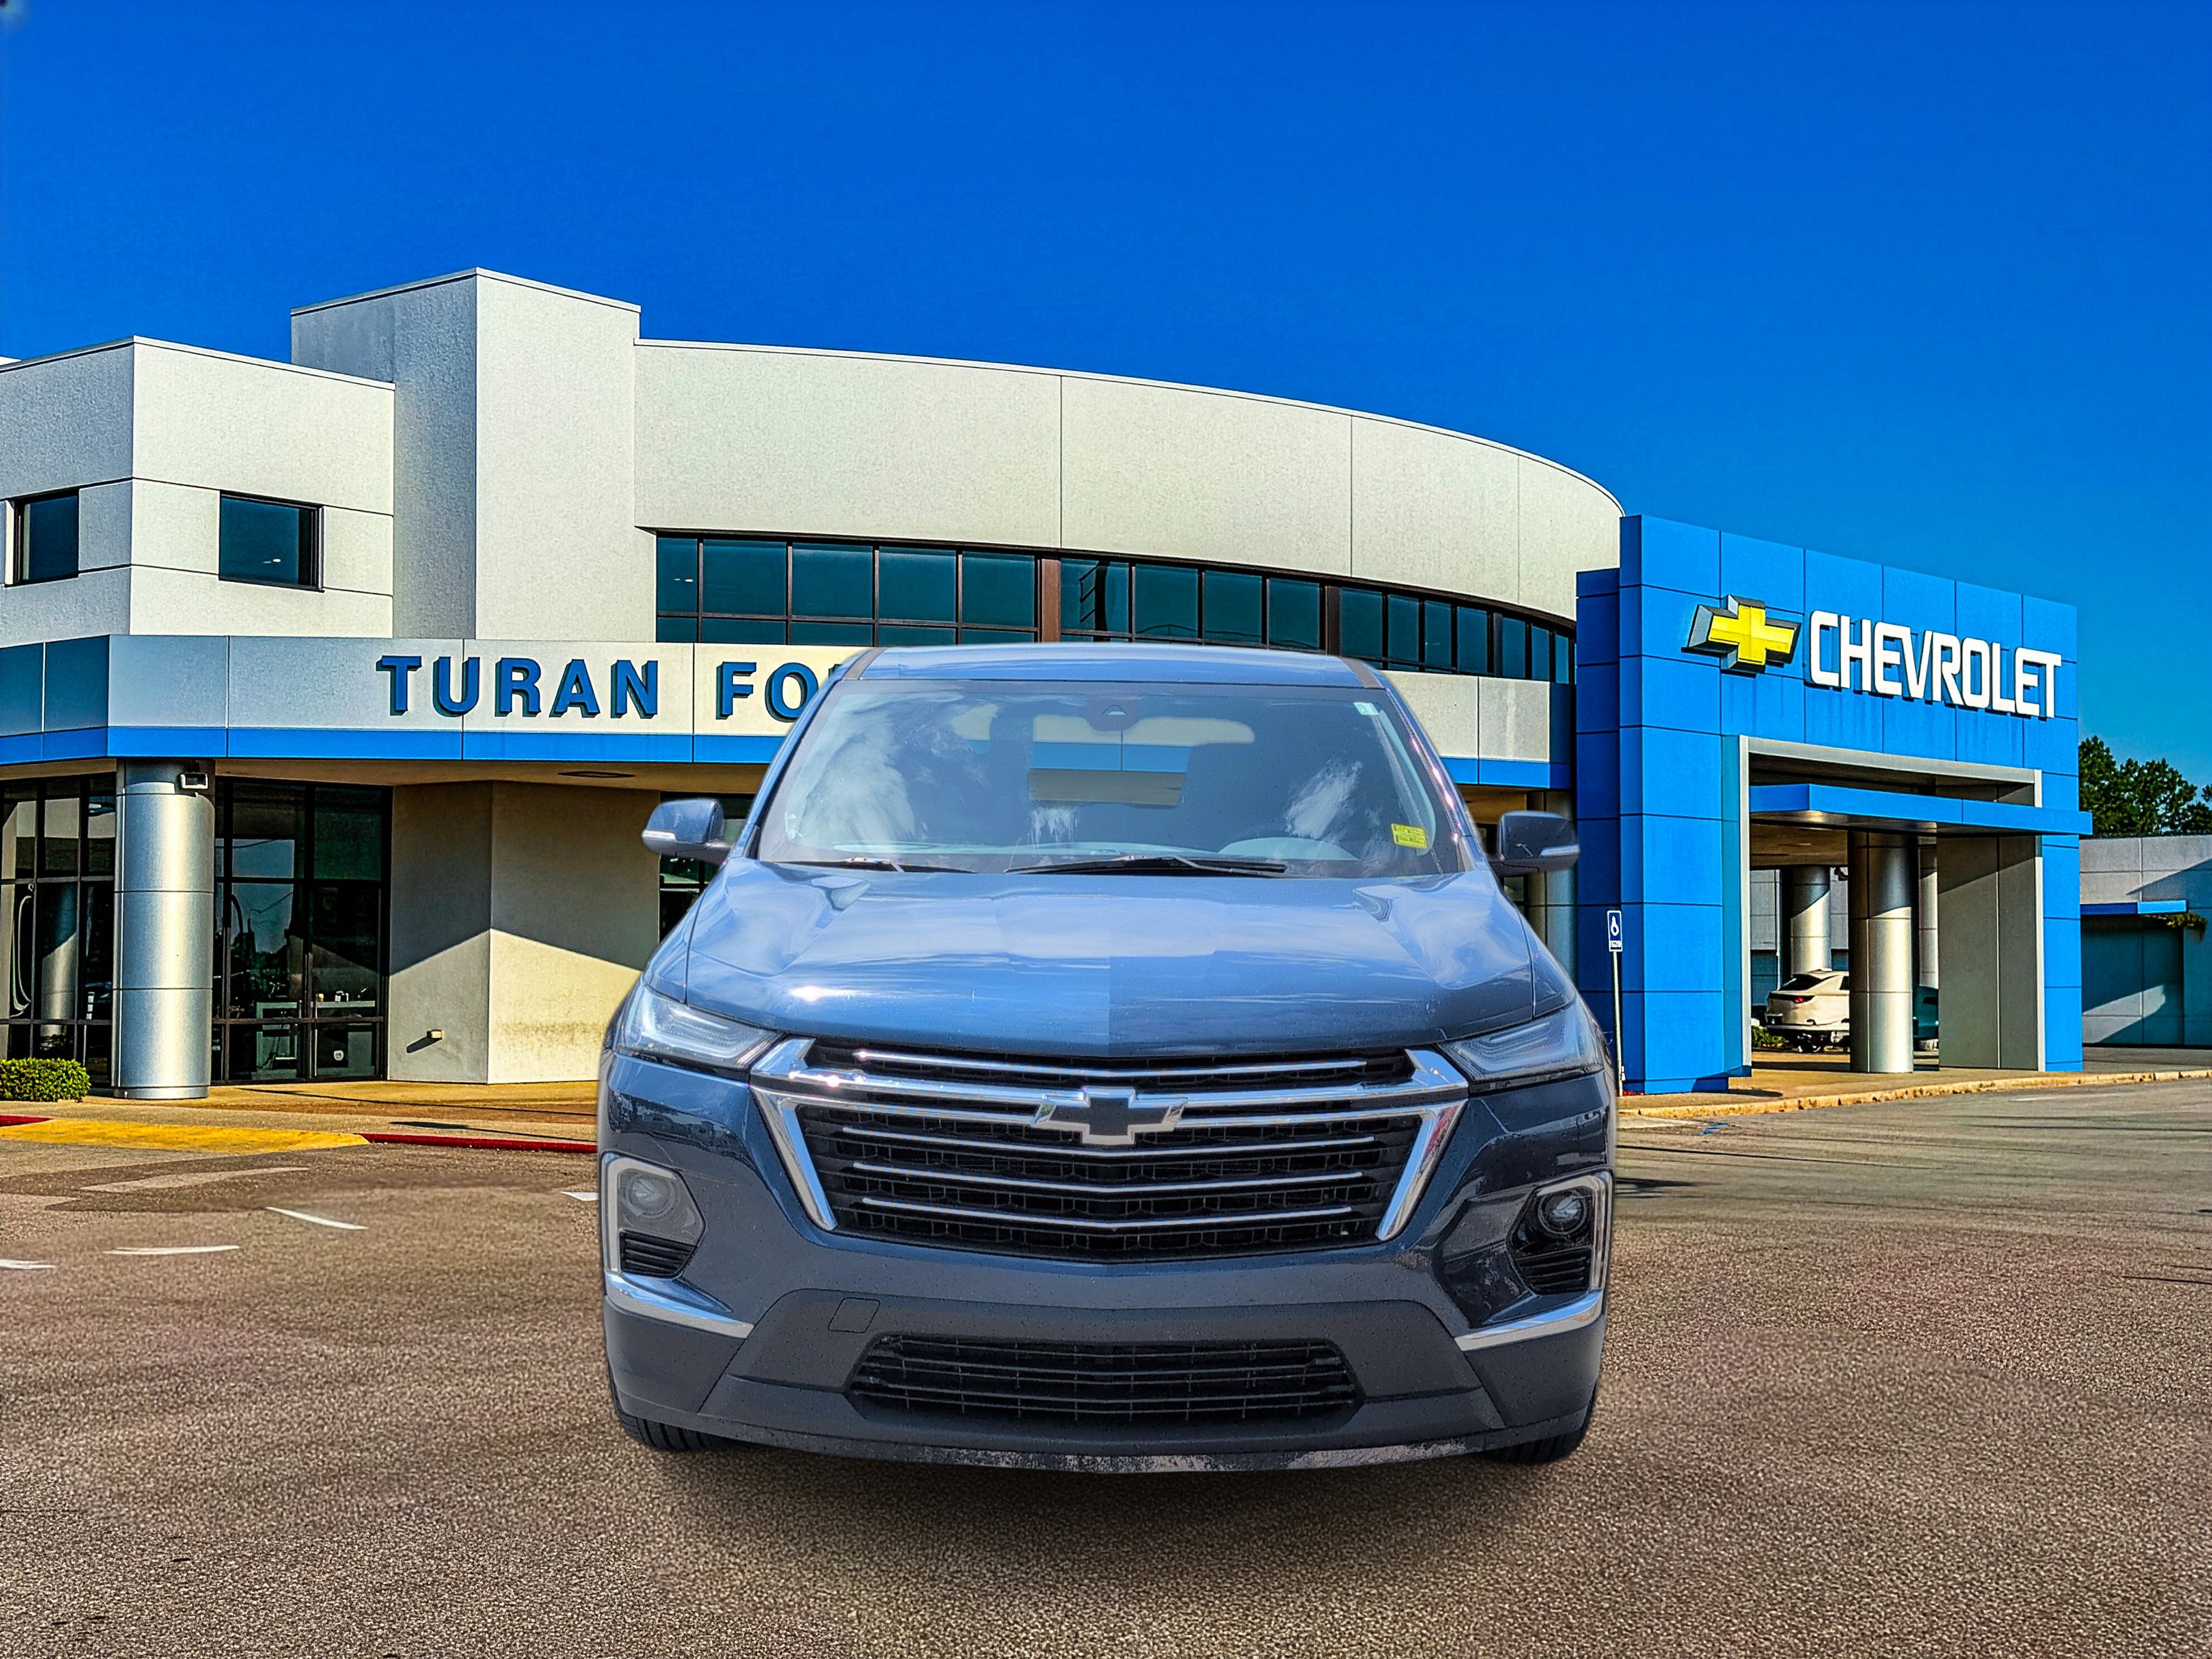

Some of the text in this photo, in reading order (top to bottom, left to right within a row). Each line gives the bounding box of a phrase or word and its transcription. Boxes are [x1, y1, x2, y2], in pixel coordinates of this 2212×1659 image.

[376, 655, 841, 723] TURAN FO
[1809, 610, 2062, 718] CHEVROLET
